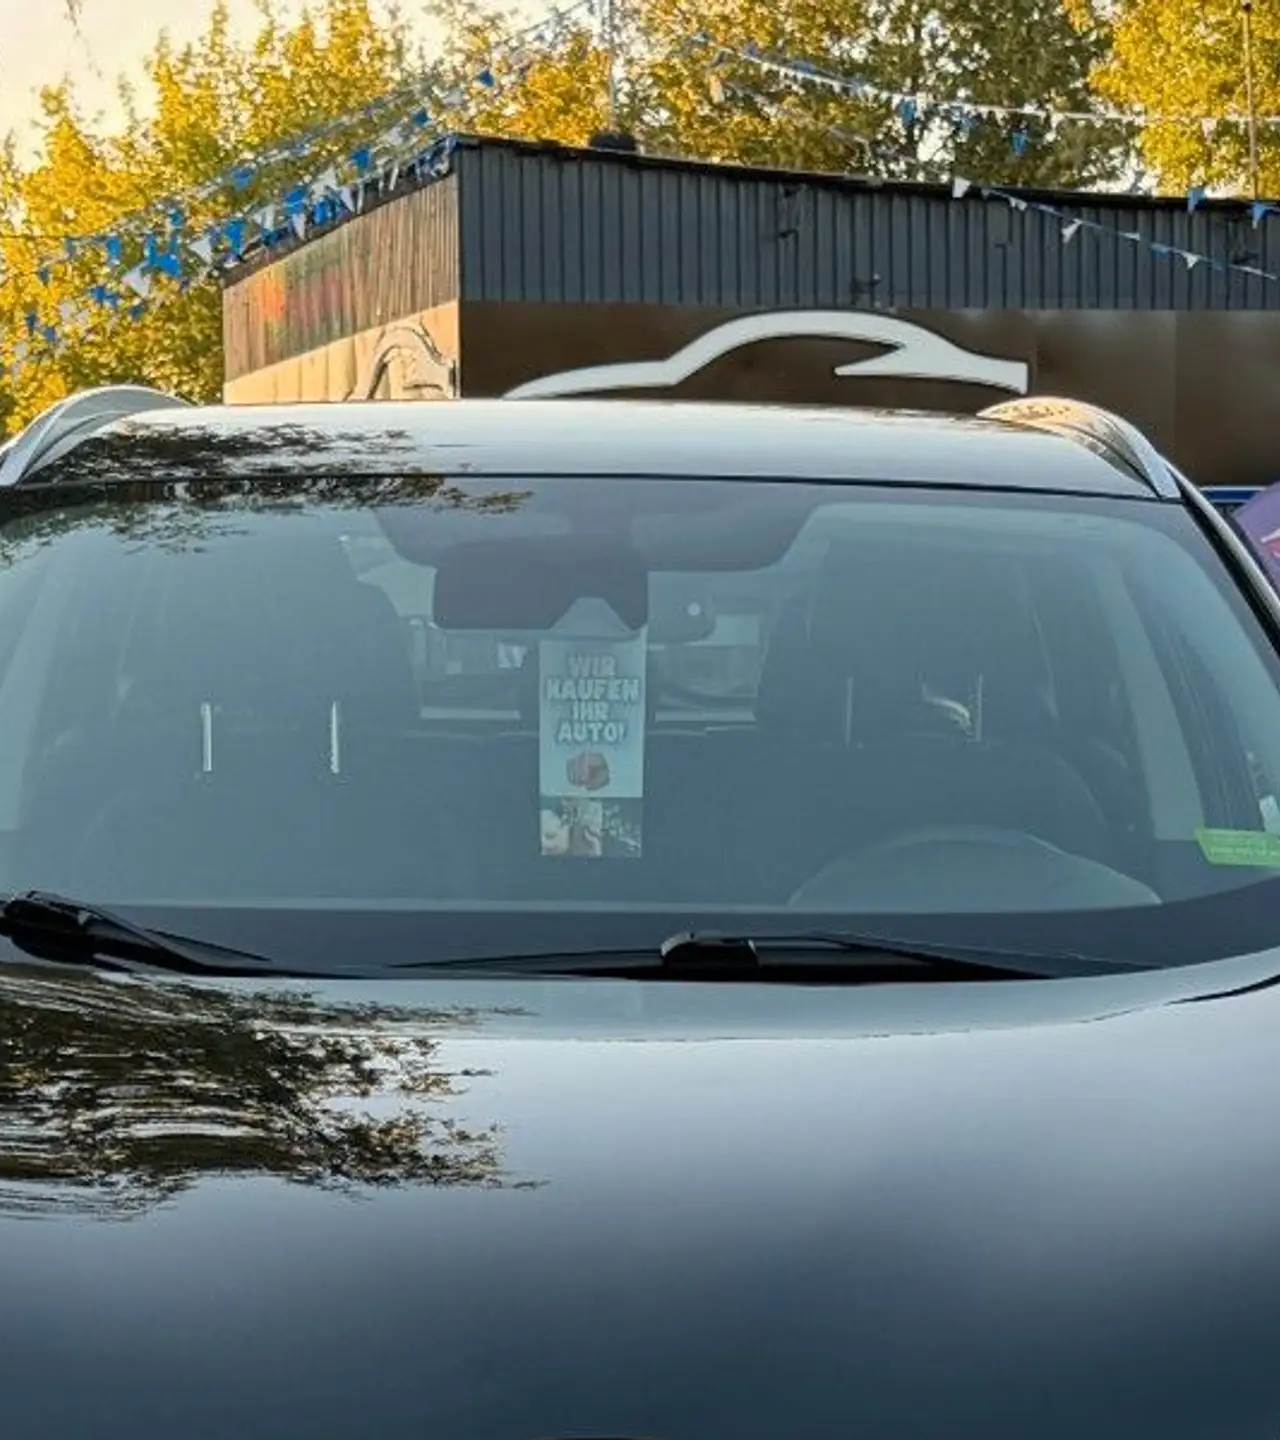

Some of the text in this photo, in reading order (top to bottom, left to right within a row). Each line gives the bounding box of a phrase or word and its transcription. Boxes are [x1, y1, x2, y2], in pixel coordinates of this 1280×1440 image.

[566, 655, 617, 678] WIR
[545, 677, 639, 701] KAUFEN
[572, 700, 610, 720] IHR
[557, 721, 627, 743] AUTO!
